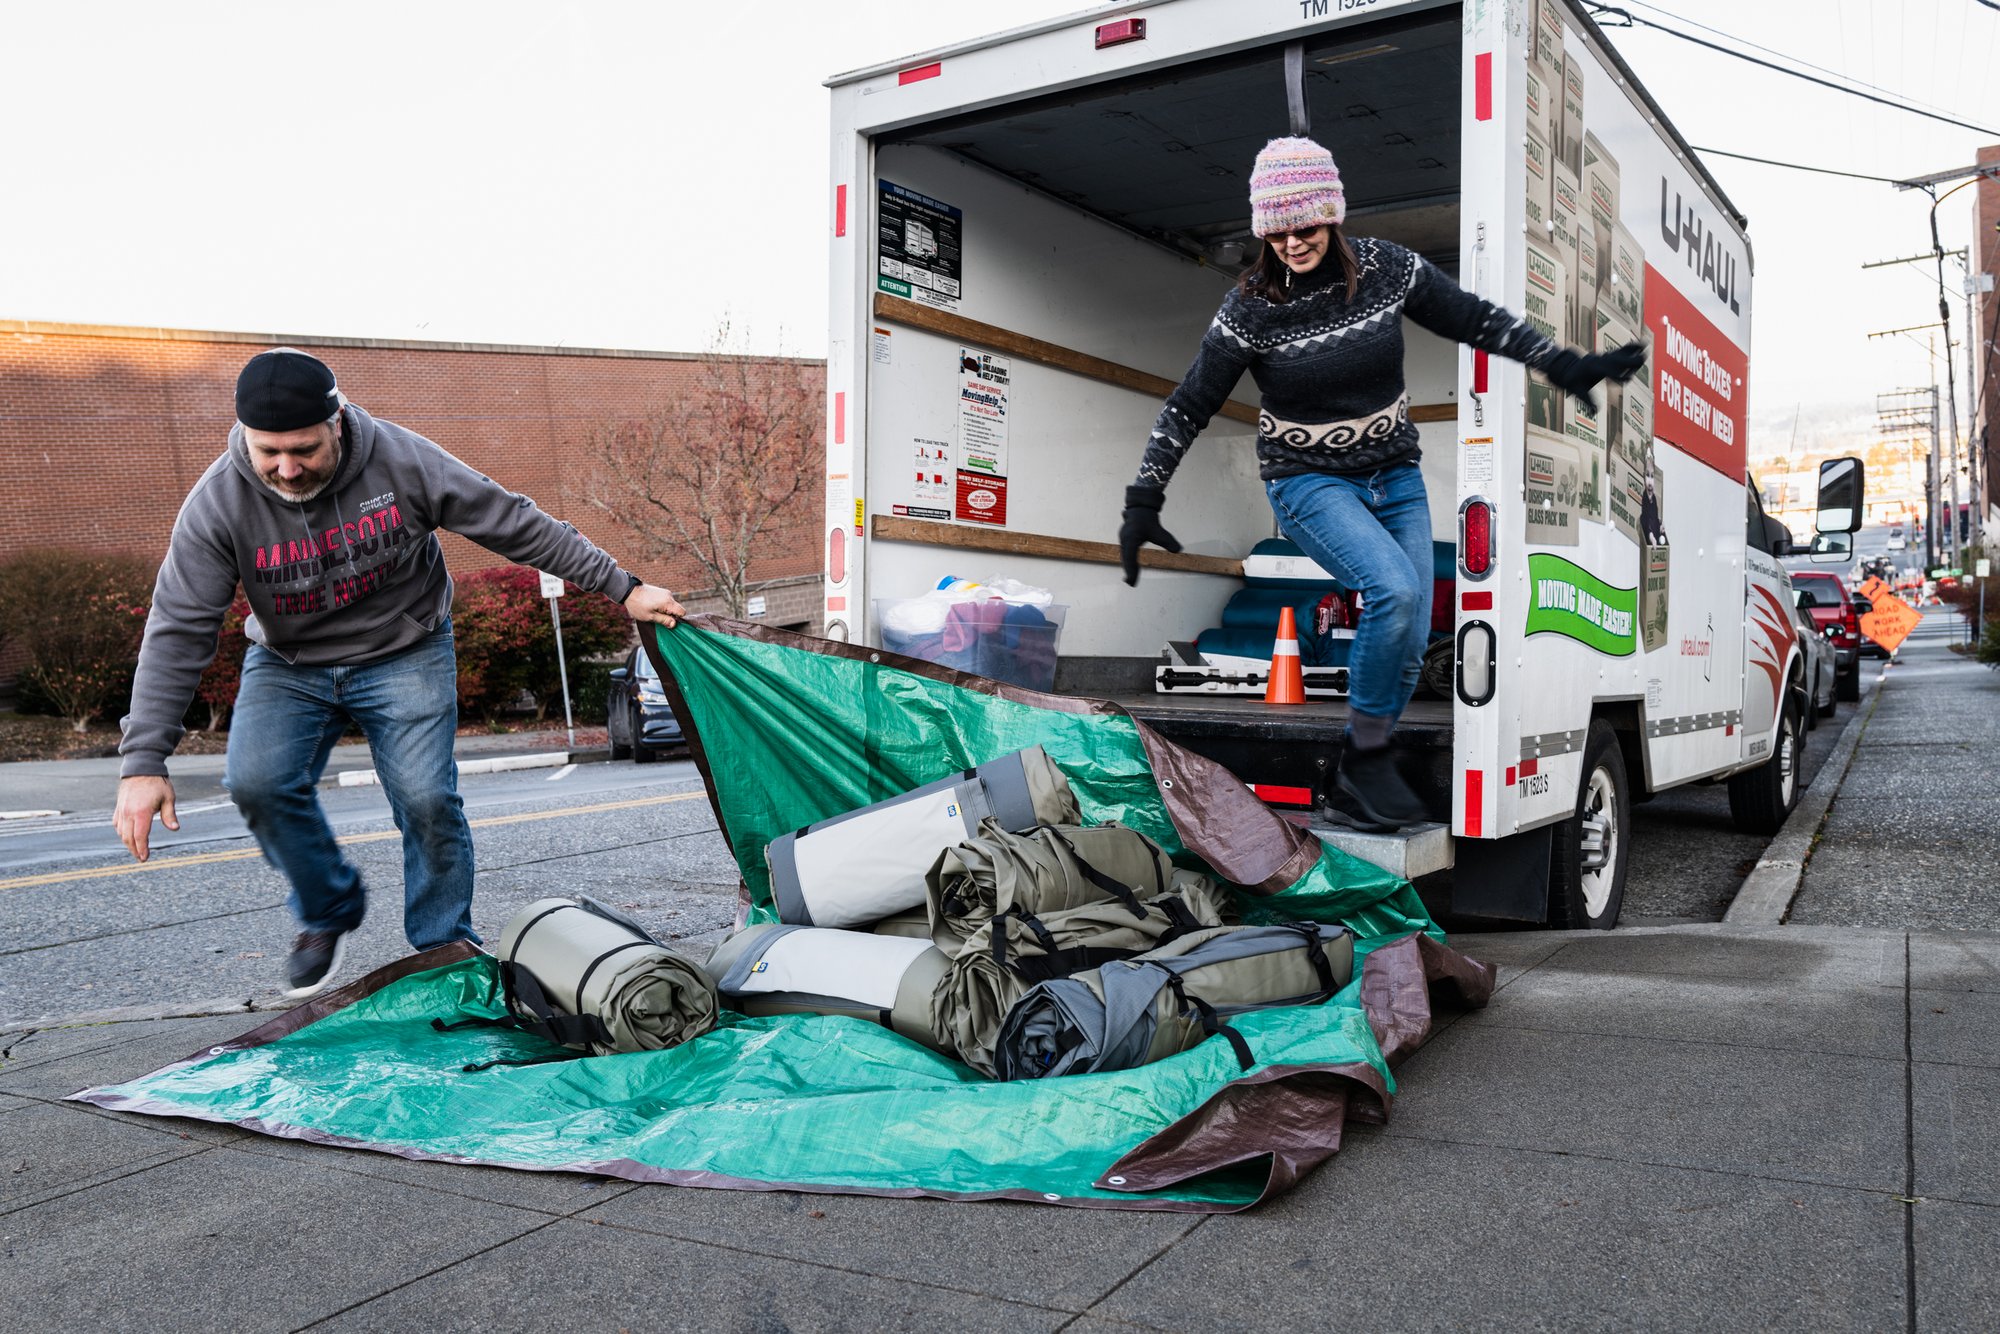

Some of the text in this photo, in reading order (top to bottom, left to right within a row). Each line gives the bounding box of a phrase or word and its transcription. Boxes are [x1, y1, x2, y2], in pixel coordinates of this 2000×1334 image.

[1300, 0, 1376, 19] TM 15
[1539, 26, 1552, 50] SPORT
[1539, 42, 1562, 76] UTILITY BOX
[893, 185, 949, 213] YOUR MOVING MADE EASIER
[1557, 179, 1576, 206] U-HAUL
[1592, 178, 1612, 208] U-HAUL
[1554, 208, 1567, 228] SPORT
[1554, 224, 1577, 251] UTILITY BOX
[1661, 175, 1740, 318] U-HAUL
[1528, 253, 1554, 283] U-HAUL
[881, 279, 908, 294] ATTENTION
[1525, 312, 1557, 343] ARDROBE
[983, 355, 992, 364] GET
[983, 364, 1007, 377] UNLOADING
[1666, 322, 1732, 402] MOVING BOXES
[968, 381, 1002, 396] SAME DAY SERVICE
[983, 372, 1010, 386] HELP TODAY!
[1661, 369, 1734, 447] FOR EVERY NEED
[1530, 459, 1553, 475] U-HAUL
[972, 477, 1006, 488] SELF-STORAGE
[359, 497, 382, 513] SINCE
[1528, 508, 1569, 528] GLASS PACK BOX
[255, 503, 412, 585] MINNESOTA
[272, 583, 329, 617] TRUE
[332, 556, 401, 610] NORTH
[1648, 576, 1666, 592] BOOK BOX
[1537, 578, 1577, 614] MOVING
[1577, 587, 1602, 628] MADE
[1602, 602, 1632, 637] EASIER!
[1873, 603, 1900, 615] ROAD
[1873, 625, 1906, 639] AHEAD
[1874, 616, 1902, 626] WORK
[1680, 634, 1710, 657] uhaul.com
[1519, 773, 1549, 799] TM 1523 S
